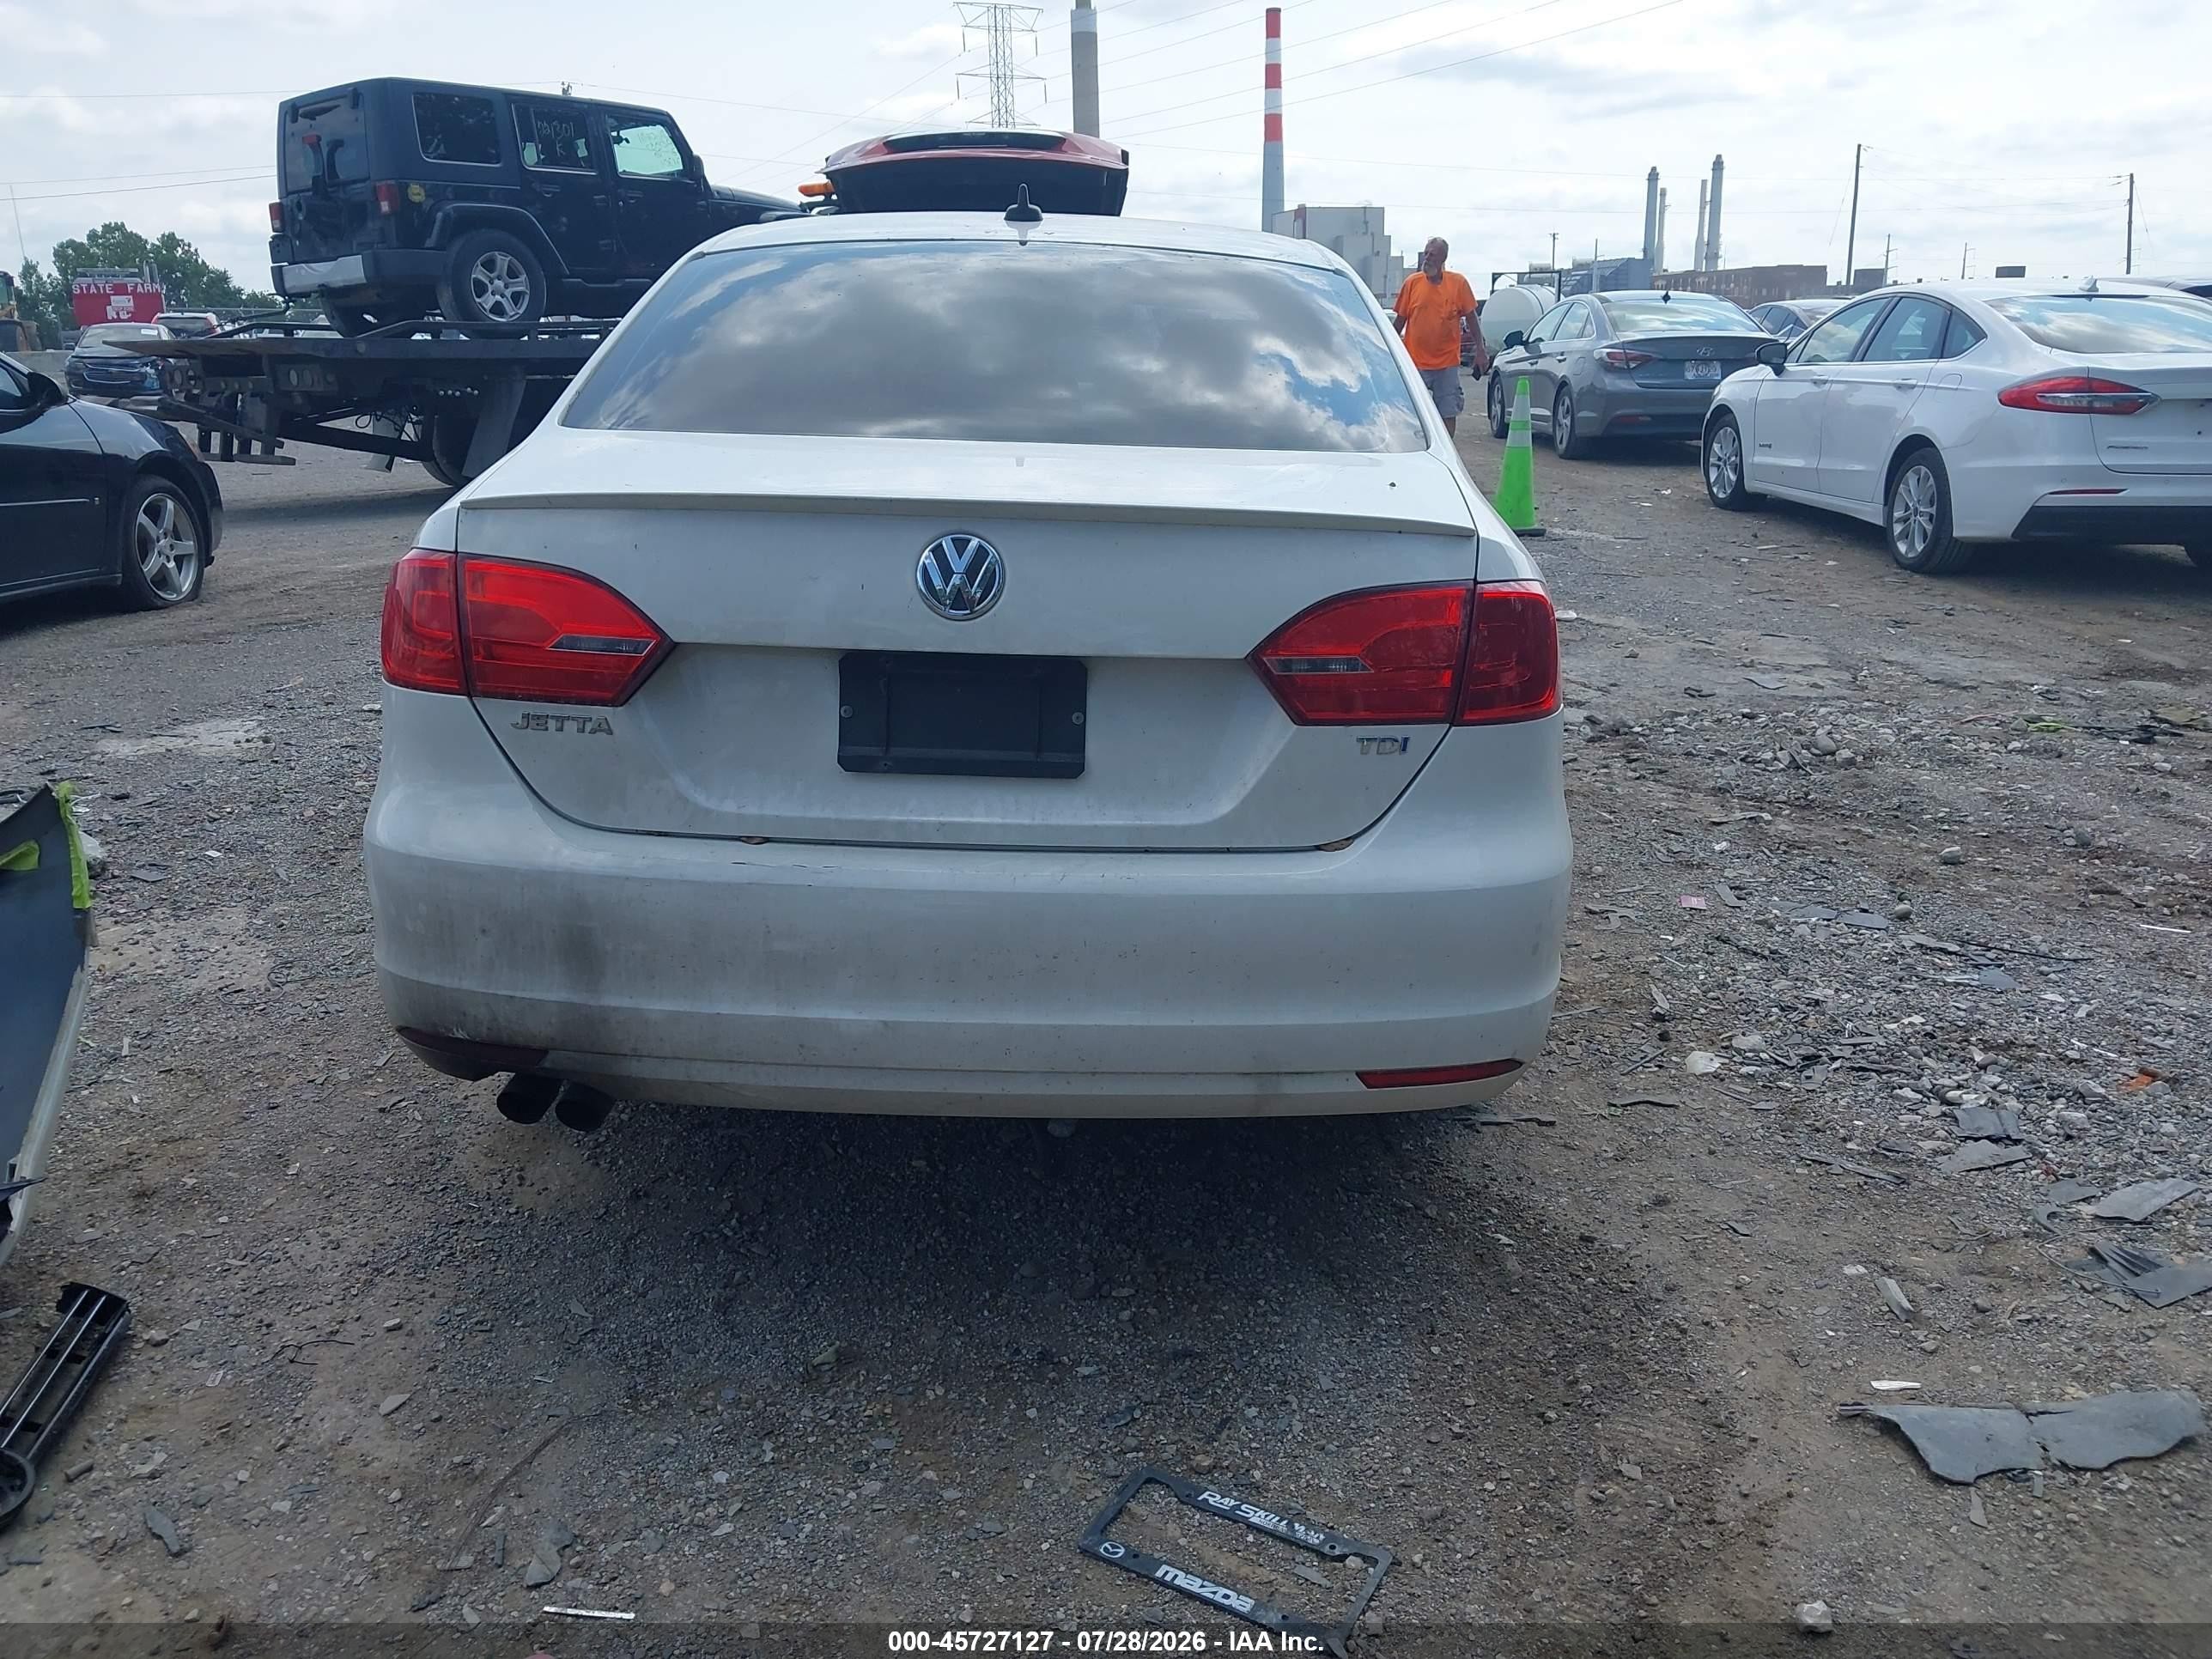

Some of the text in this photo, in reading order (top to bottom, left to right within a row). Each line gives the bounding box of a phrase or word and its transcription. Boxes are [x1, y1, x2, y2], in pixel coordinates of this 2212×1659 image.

[71, 283, 161, 294] STATE FARM
[510, 711, 614, 736] JETTA
[1197, 1491, 1242, 1510] RAY
